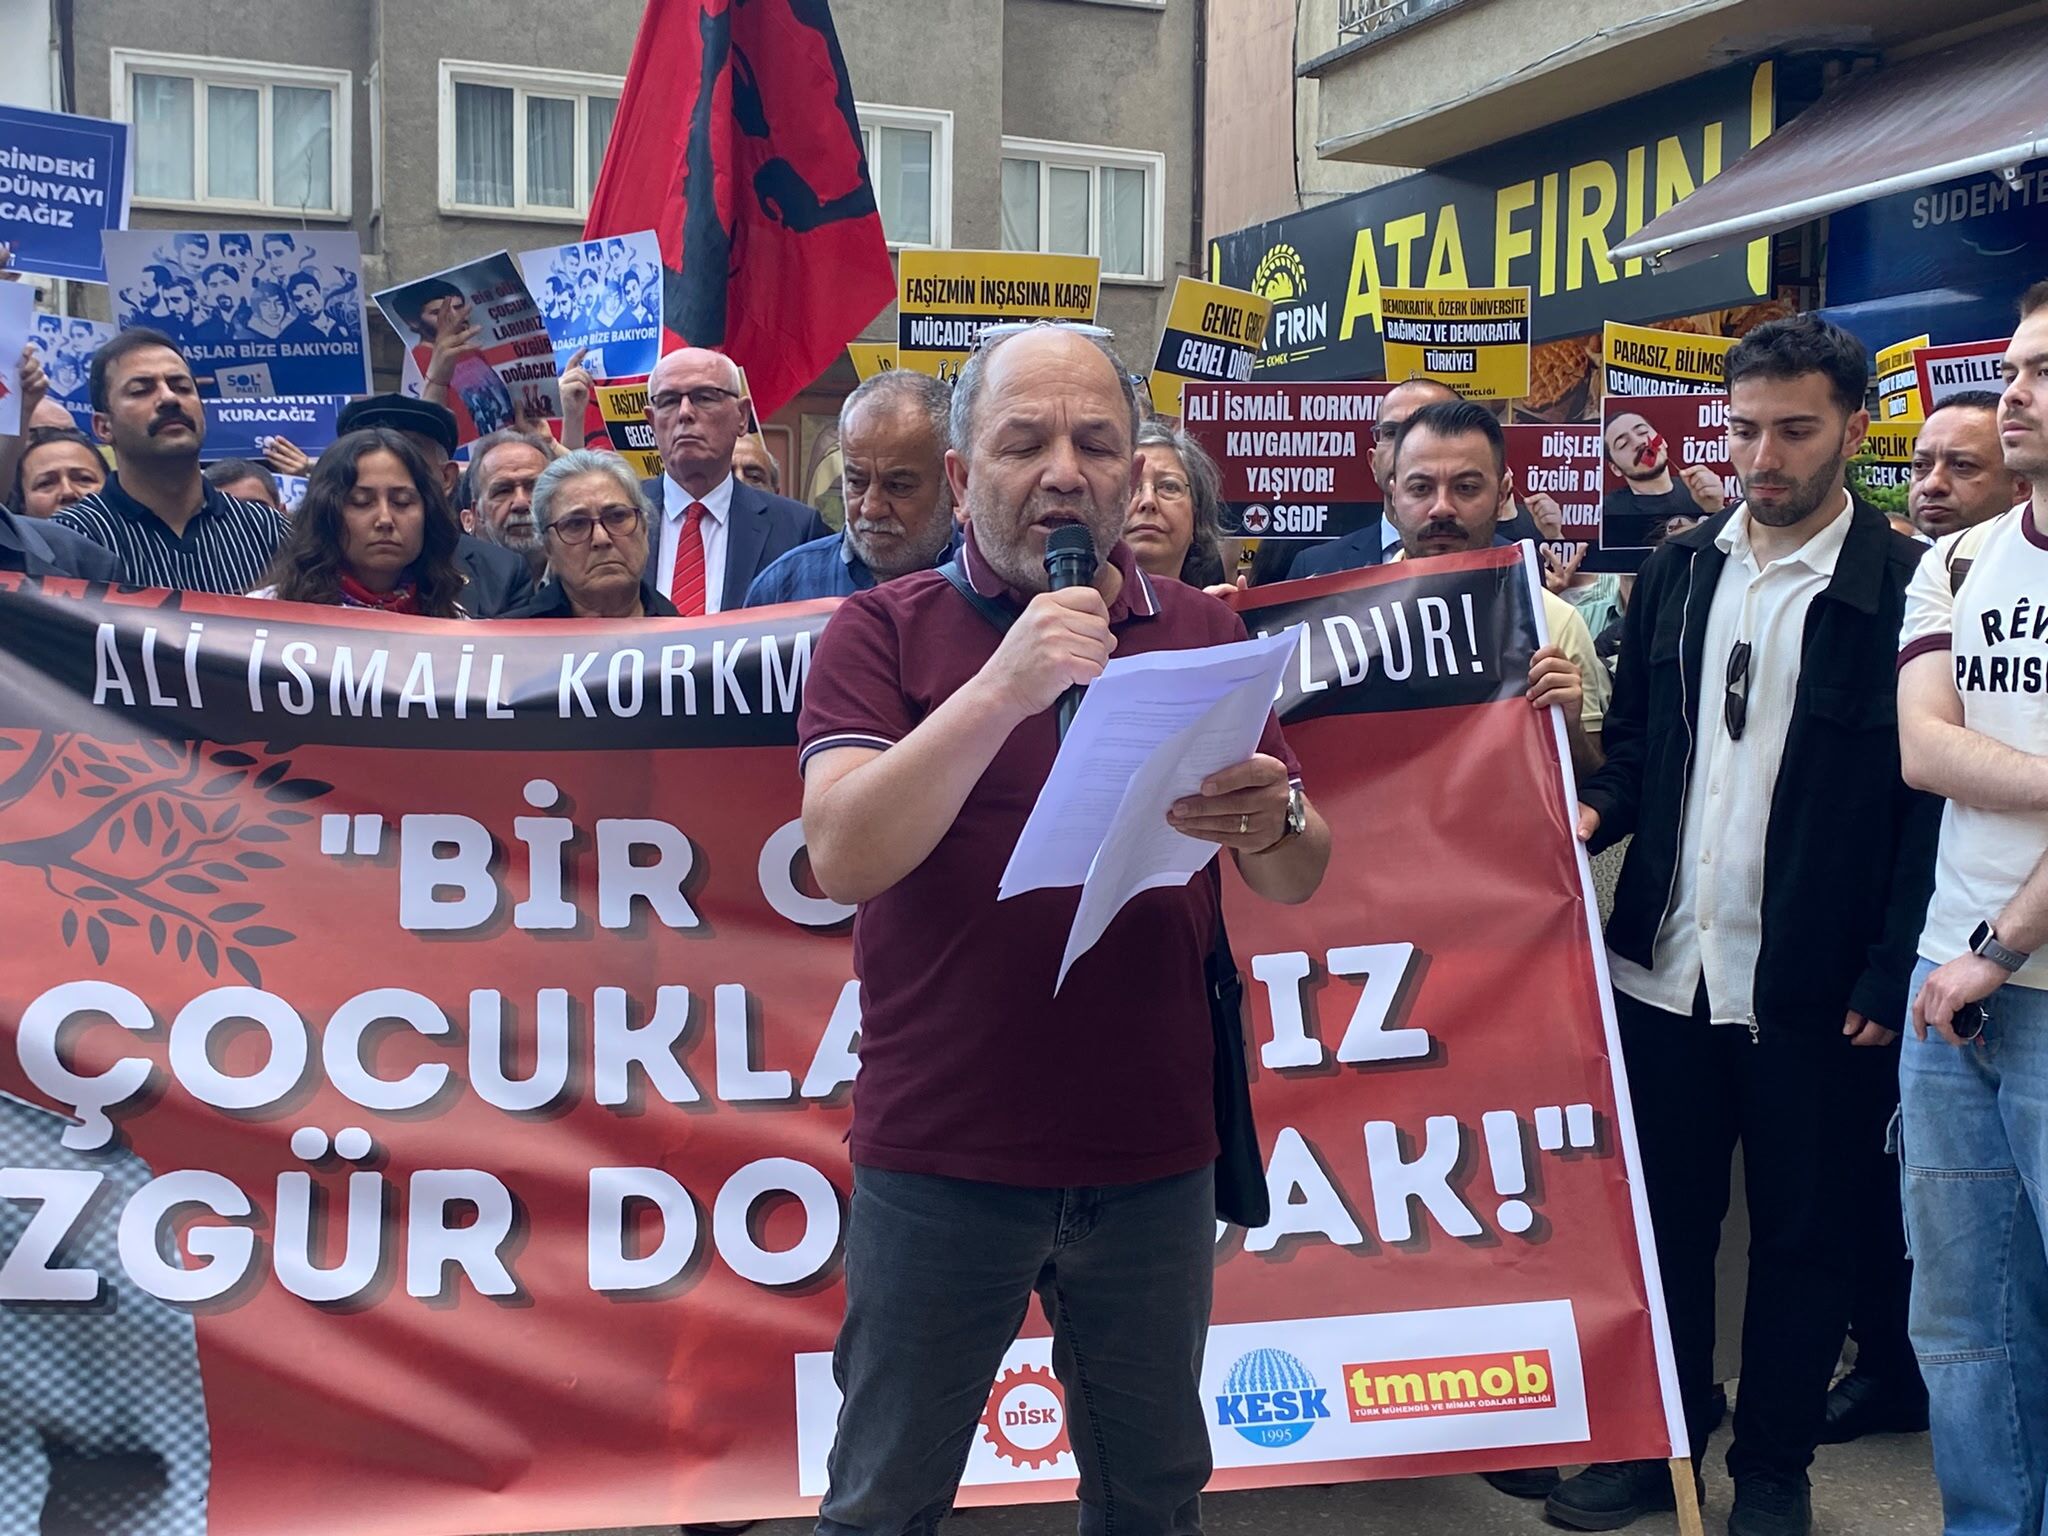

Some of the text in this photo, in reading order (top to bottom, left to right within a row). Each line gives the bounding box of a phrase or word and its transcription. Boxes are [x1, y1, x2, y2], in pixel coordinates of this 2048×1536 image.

[0, 146, 95, 180] RİNDEKİ
[0, 174, 104, 207] DÜNYAYI
[1912, 181, 2010, 229] SUDEM
[0, 202, 74, 228] CAĞIZ
[1339, 204, 1469, 341] ATA
[907, 274, 1092, 313] FAŞİZMİN İNŞASINA KARŞI
[1383, 297, 1526, 317] DEMOKRATİK, ÖZERK ÜNİVERSİTE
[590, 331, 610, 344] BİZE
[611, 327, 658, 343] BAKIYOR!
[1201, 302, 1243, 339] GENEL
[1276, 301, 1328, 348] FIRIN
[1387, 320, 1521, 343] BAĞIMSIZ VE DEMOKRATİK
[240, 342, 277, 358] BİZE
[281, 342, 359, 357] BAKIYOR!
[1177, 338, 1225, 378] GENEL
[1426, 350, 1473, 371] TÜRKİYE!
[1613, 340, 1671, 373] PARASIZ,
[501, 361, 557, 384] DOĞACAK!
[1932, 359, 2003, 385] KATİLLE
[218, 405, 317, 422] KURACAĞIZ
[1188, 390, 1219, 421] ALİ
[1224, 390, 1294, 421] İSMAİL
[1226, 431, 1356, 457] KAVGAMIZDA
[1246, 467, 1335, 500] YAŞIYOR!
[1527, 466, 1579, 492] ÖZGÜR
[1273, 505, 1328, 532] SGDF
[1981, 597, 2048, 647] RÊV
[93, 622, 204, 709] ALİ
[248, 628, 516, 721] İSMAİL
[1956, 655, 2048, 694] PARIS
[1251, 942, 1430, 1068] IZ
[588, 1157, 842, 1291] DO
[1216, 1103, 1595, 1252] AK!"
[1349, 1356, 1548, 1407] tmmob
[1005, 1401, 1056, 1426] DİSK
[1215, 1388, 1331, 1425] KESK
[1354, 1394, 1551, 1416] TÜRK MÜHENDİS VE MİMAR ODALARI BİRLİĞİ
[1260, 1429, 1293, 1444] 1995
